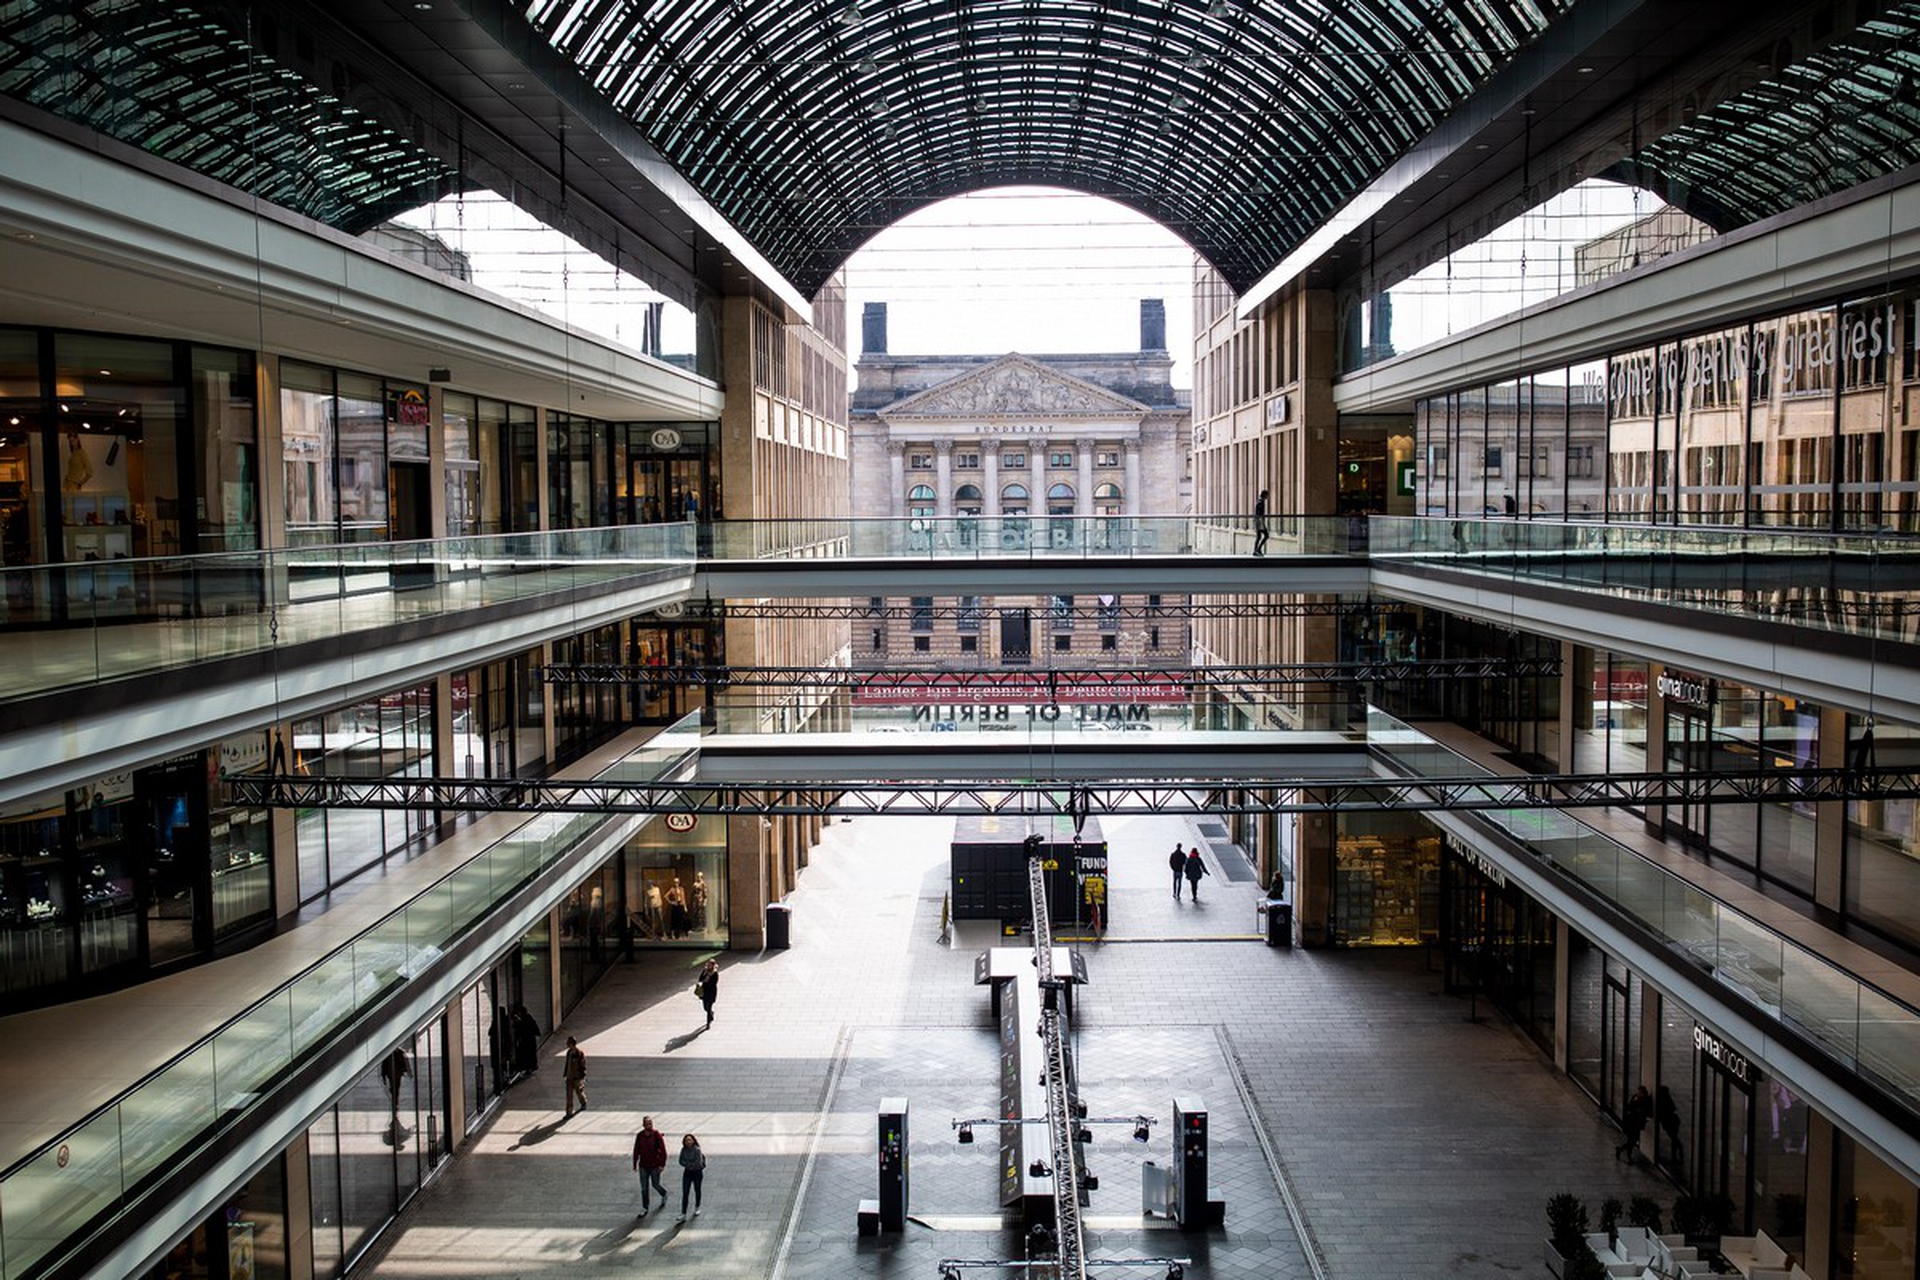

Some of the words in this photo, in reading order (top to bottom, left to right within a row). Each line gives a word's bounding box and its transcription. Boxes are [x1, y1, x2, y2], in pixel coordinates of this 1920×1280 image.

[1782, 304, 1896, 384] greatest
[975, 424, 1053, 433] BUNDESRAT
[655, 432, 676, 445] C&A
[670, 815, 690, 826] C&A
